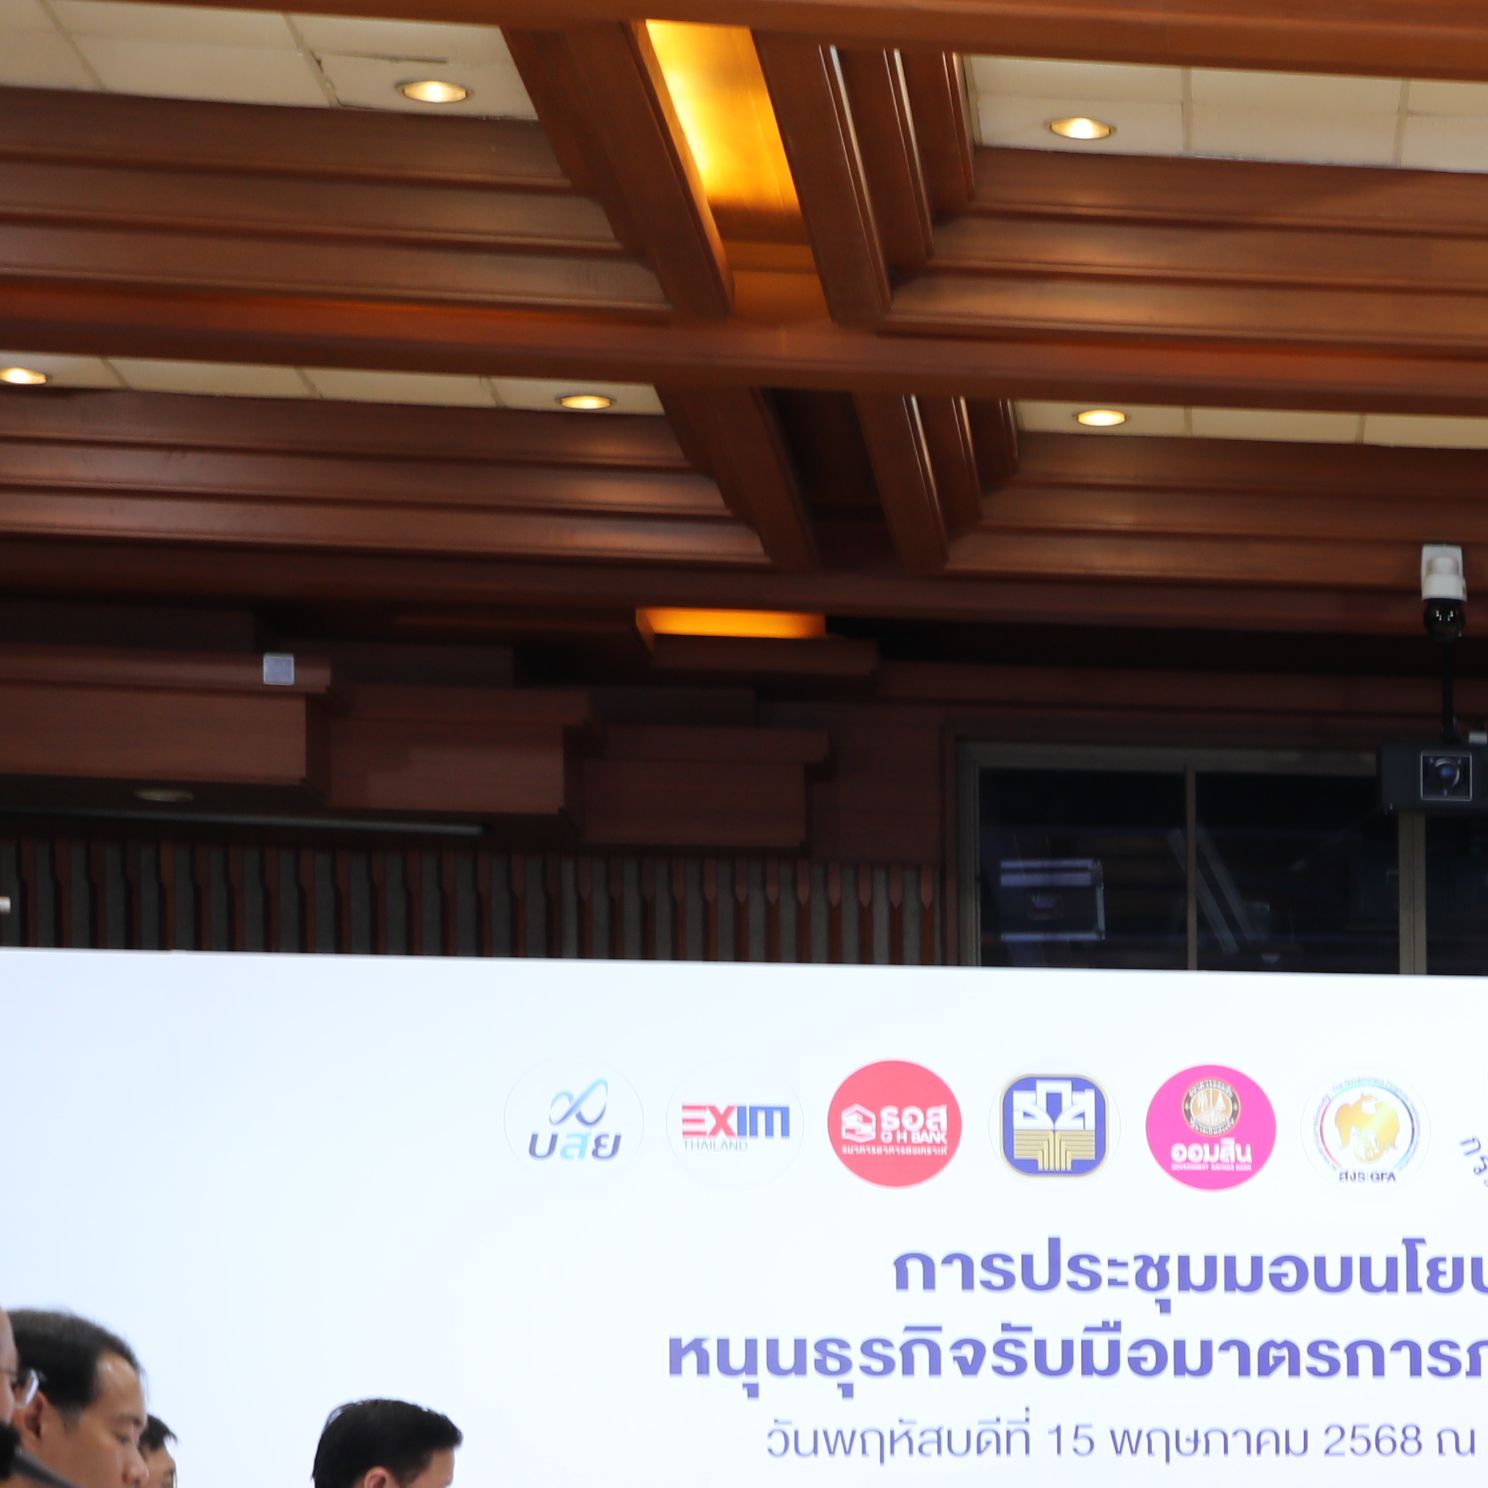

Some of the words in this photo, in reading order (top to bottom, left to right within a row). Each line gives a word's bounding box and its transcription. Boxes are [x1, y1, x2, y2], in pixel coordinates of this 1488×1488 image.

[682, 1103, 791, 1139] EXIM
[880, 1104, 948, 1131] ธอส
[530, 1133, 622, 1161] บสย
[683, 1139, 748, 1152] THAILAND
[911, 1130, 948, 1144] BANK
[1171, 1137, 1253, 1163] ออมสิน
[768, 1406, 1032, 1466] วันพฤหัสบดีที่
[1049, 1424, 1096, 1458] 15
[1110, 1428, 1310, 1466] พฤษภาคม
[1325, 1424, 1424, 1458] 2568
[1438, 1428, 1476, 1458] ณ
